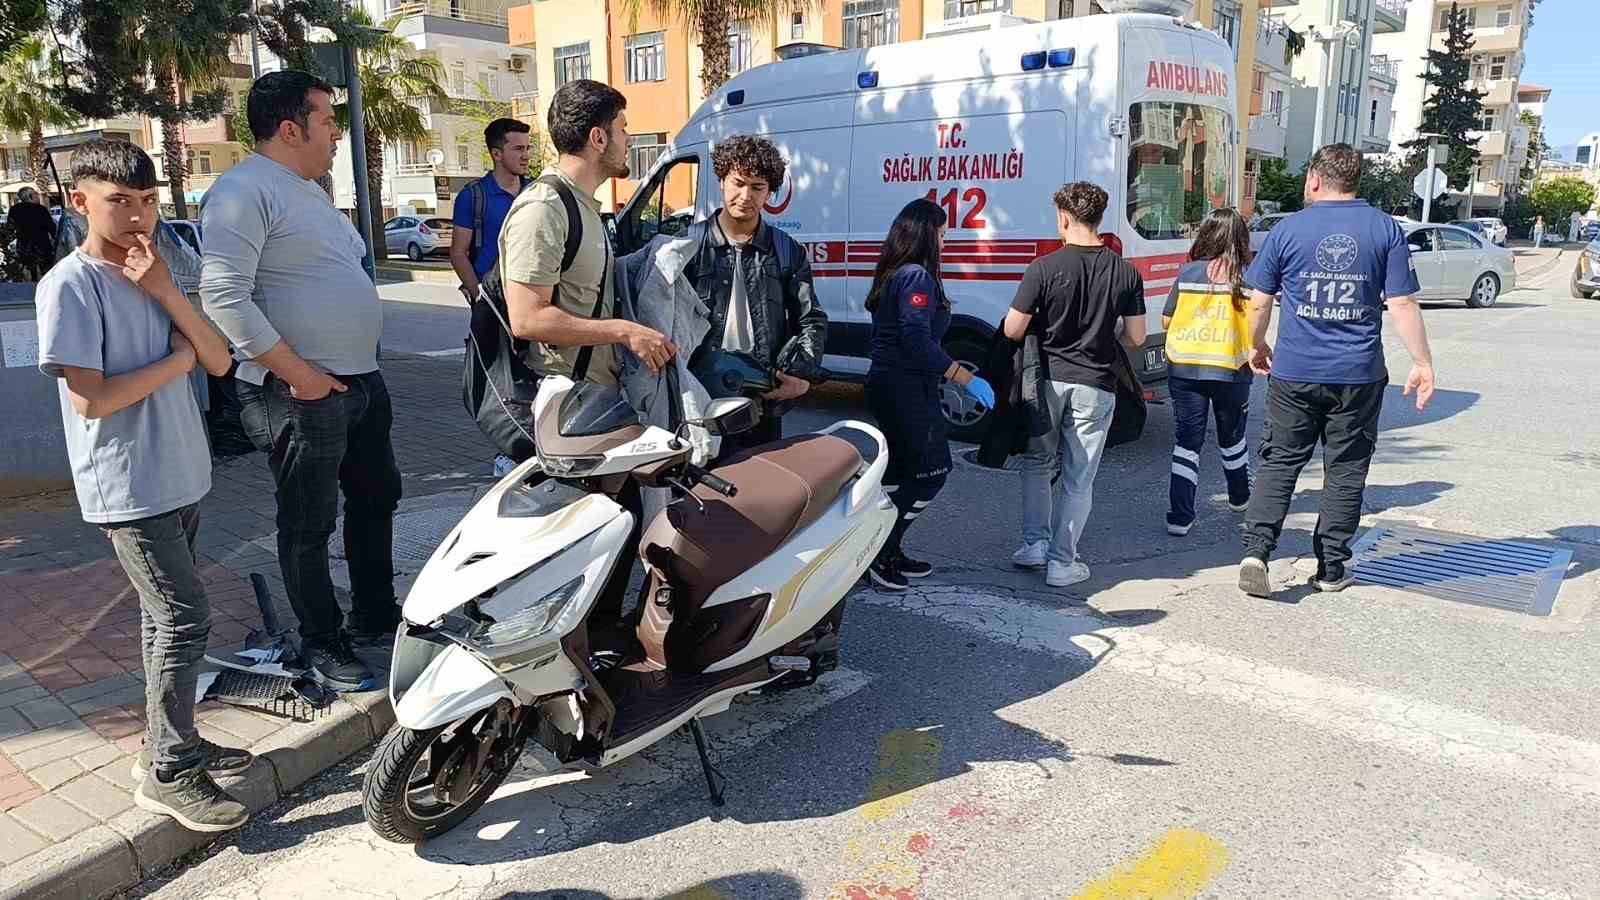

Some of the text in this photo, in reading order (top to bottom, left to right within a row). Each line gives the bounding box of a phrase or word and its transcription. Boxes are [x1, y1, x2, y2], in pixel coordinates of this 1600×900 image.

[1146, 60, 1228, 98] AMBULANS
[937, 122, 967, 149] T.C.
[883, 148, 1024, 183] SAĞLIK BAKANLIĞI
[1305, 280, 1356, 304] 112
[1296, 304, 1365, 320] ACİL SAĞLIK
[631, 441, 658, 453] 125
